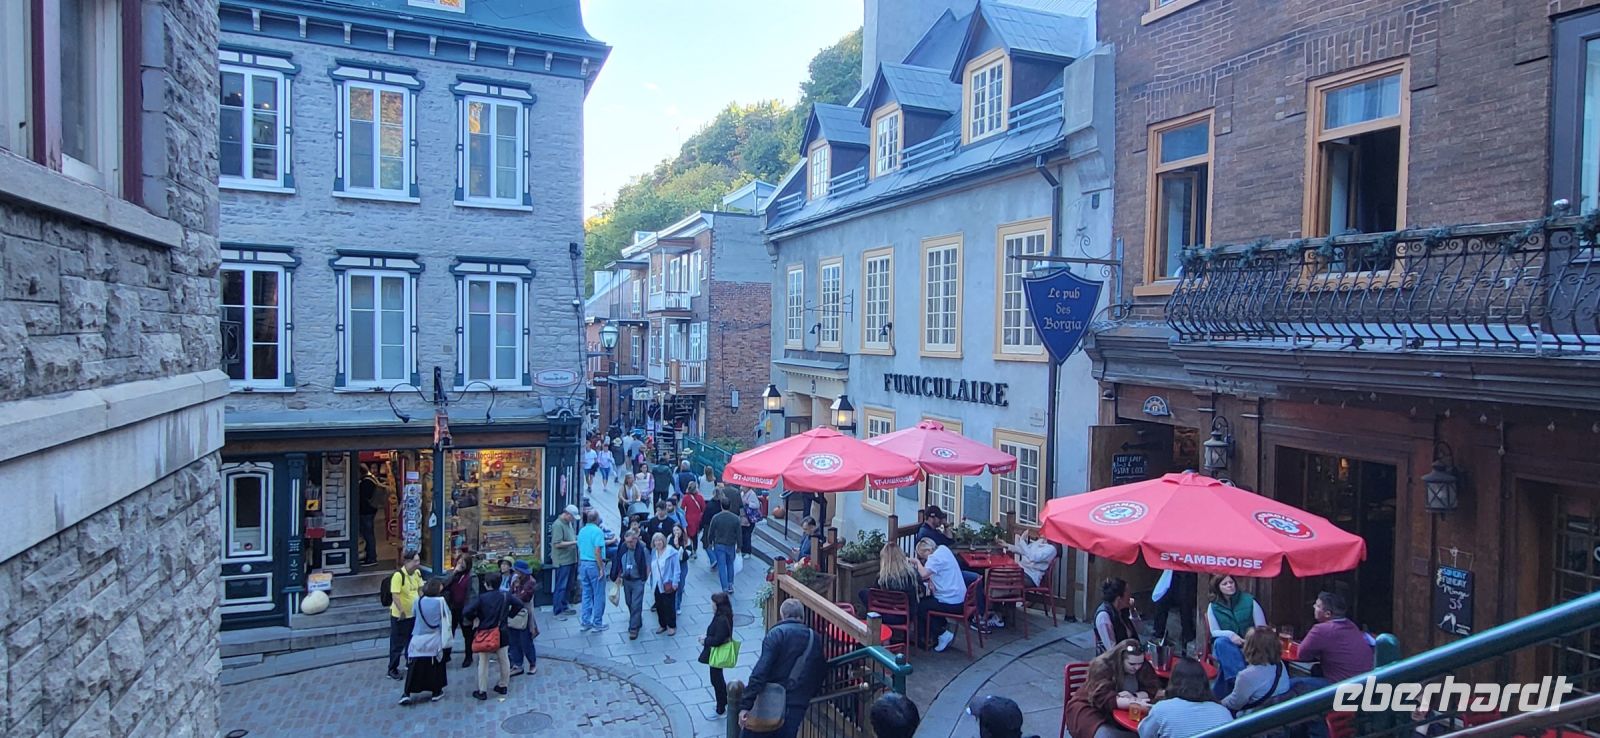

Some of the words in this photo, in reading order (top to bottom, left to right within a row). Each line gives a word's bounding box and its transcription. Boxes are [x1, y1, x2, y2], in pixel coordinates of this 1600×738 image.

[1047, 287, 1061, 298] Le
[1063, 287, 1081, 300] pub
[1055, 302, 1071, 315] des
[1043, 317, 1082, 332] Borgia
[883, 373, 1009, 407] FUNICULAIRE
[1160, 552, 1263, 569] ST-AMBROISE
